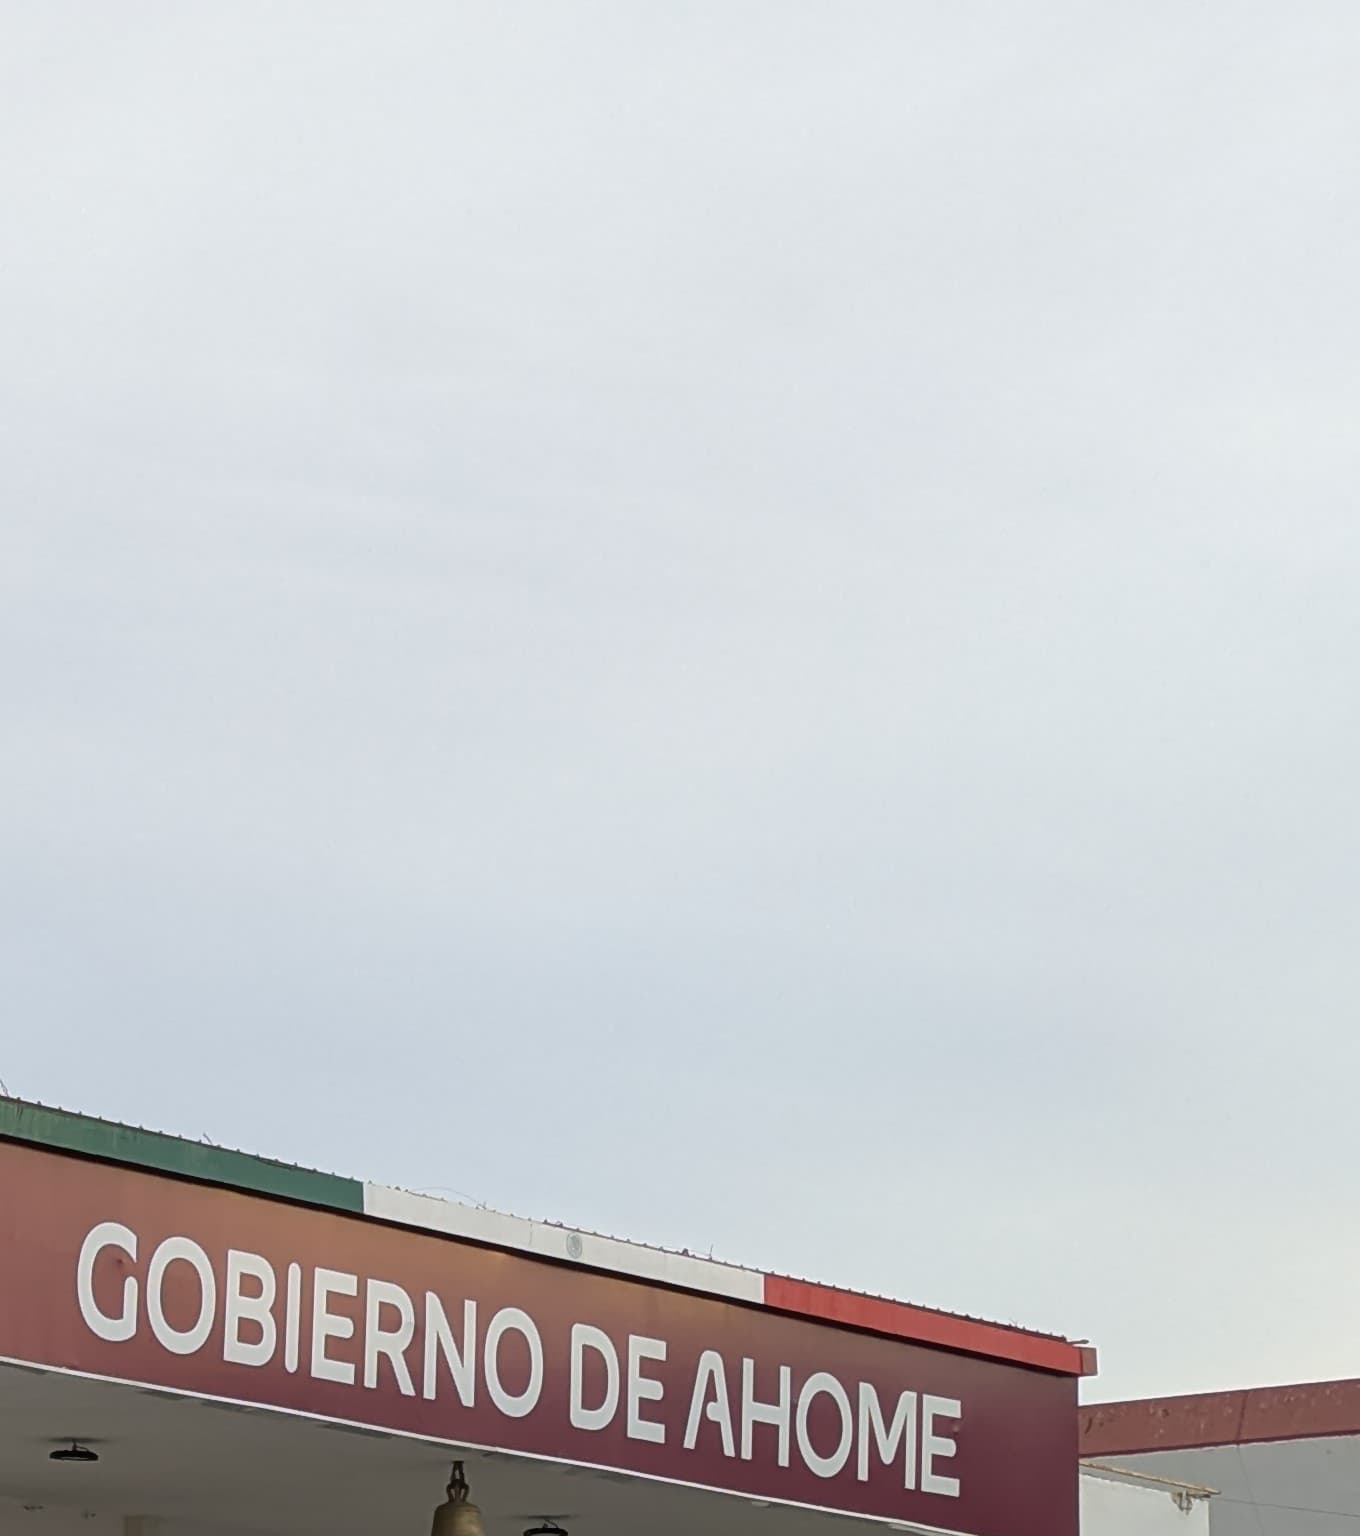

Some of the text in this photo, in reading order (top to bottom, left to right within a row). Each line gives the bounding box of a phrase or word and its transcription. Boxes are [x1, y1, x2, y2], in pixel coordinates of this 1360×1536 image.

[77, 1222, 962, 1498] GOBIERNO DE AHOME
